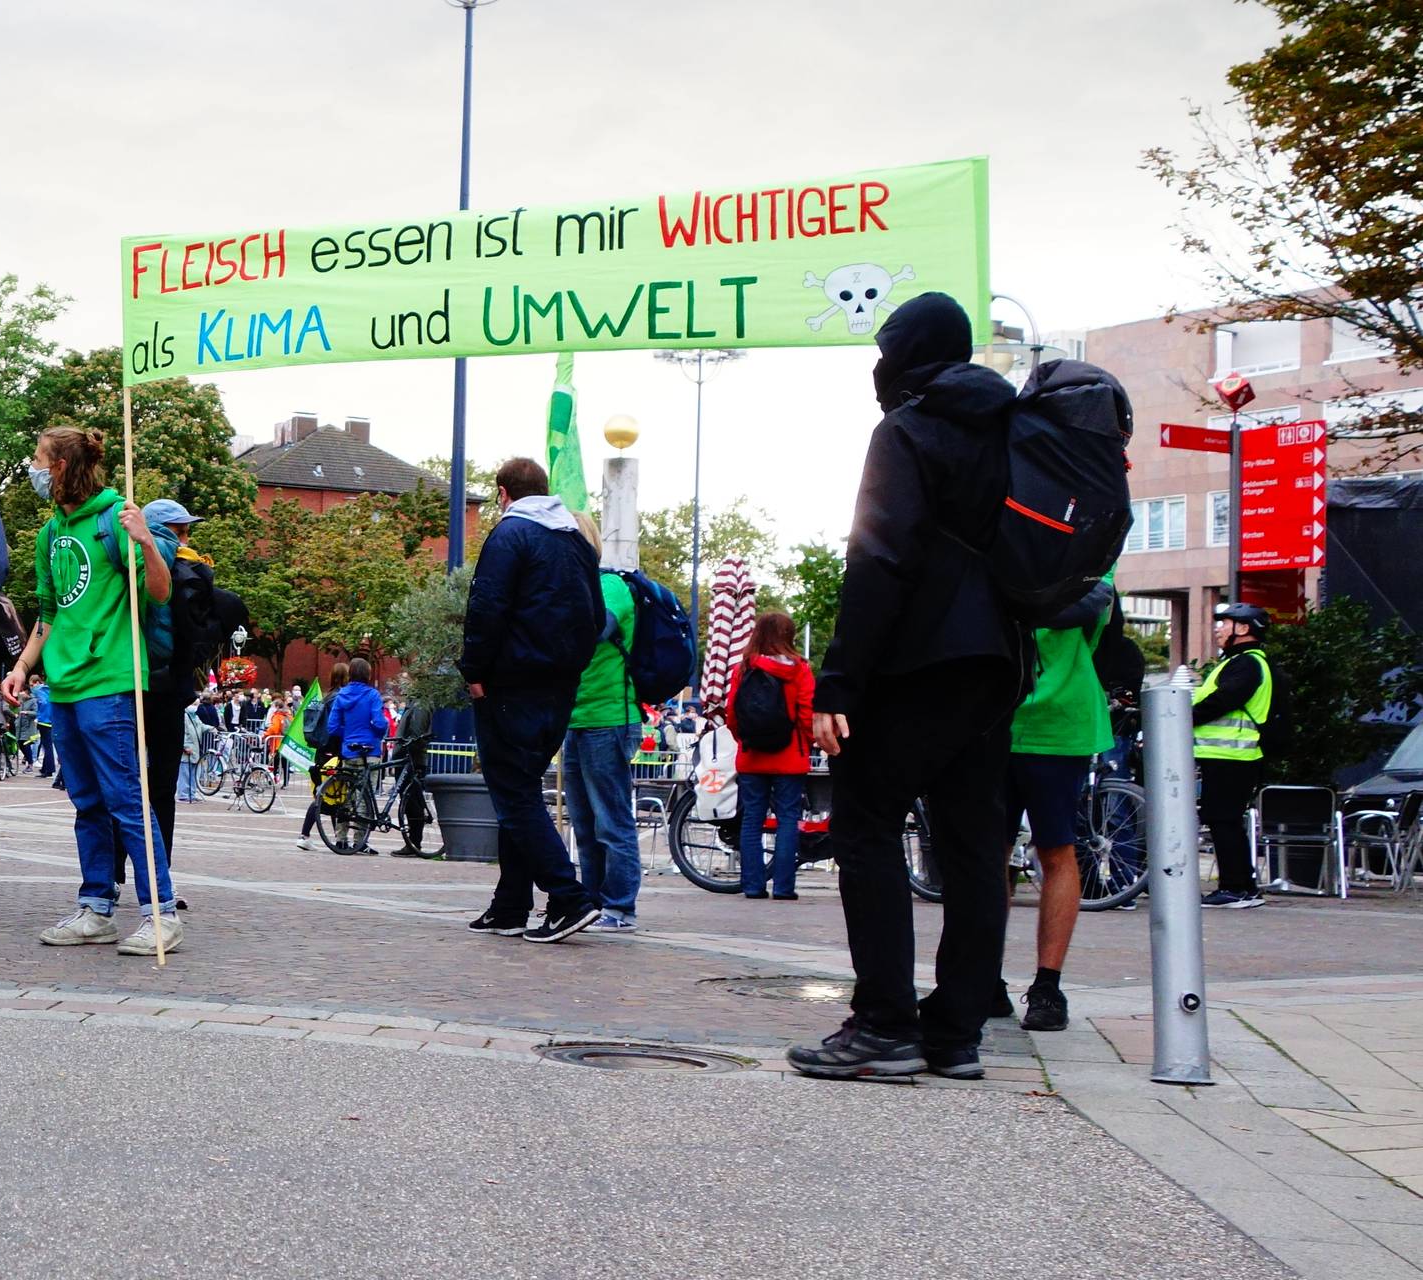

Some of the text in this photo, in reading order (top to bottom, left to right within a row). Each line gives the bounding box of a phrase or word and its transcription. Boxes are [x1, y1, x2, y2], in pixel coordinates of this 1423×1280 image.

[132, 181, 890, 300] FLEISCH essen ist mir WICHTIGER
[131, 276, 759, 375] als KLIMA und UMWELT
[62, 564, 88, 604] FUTURE
